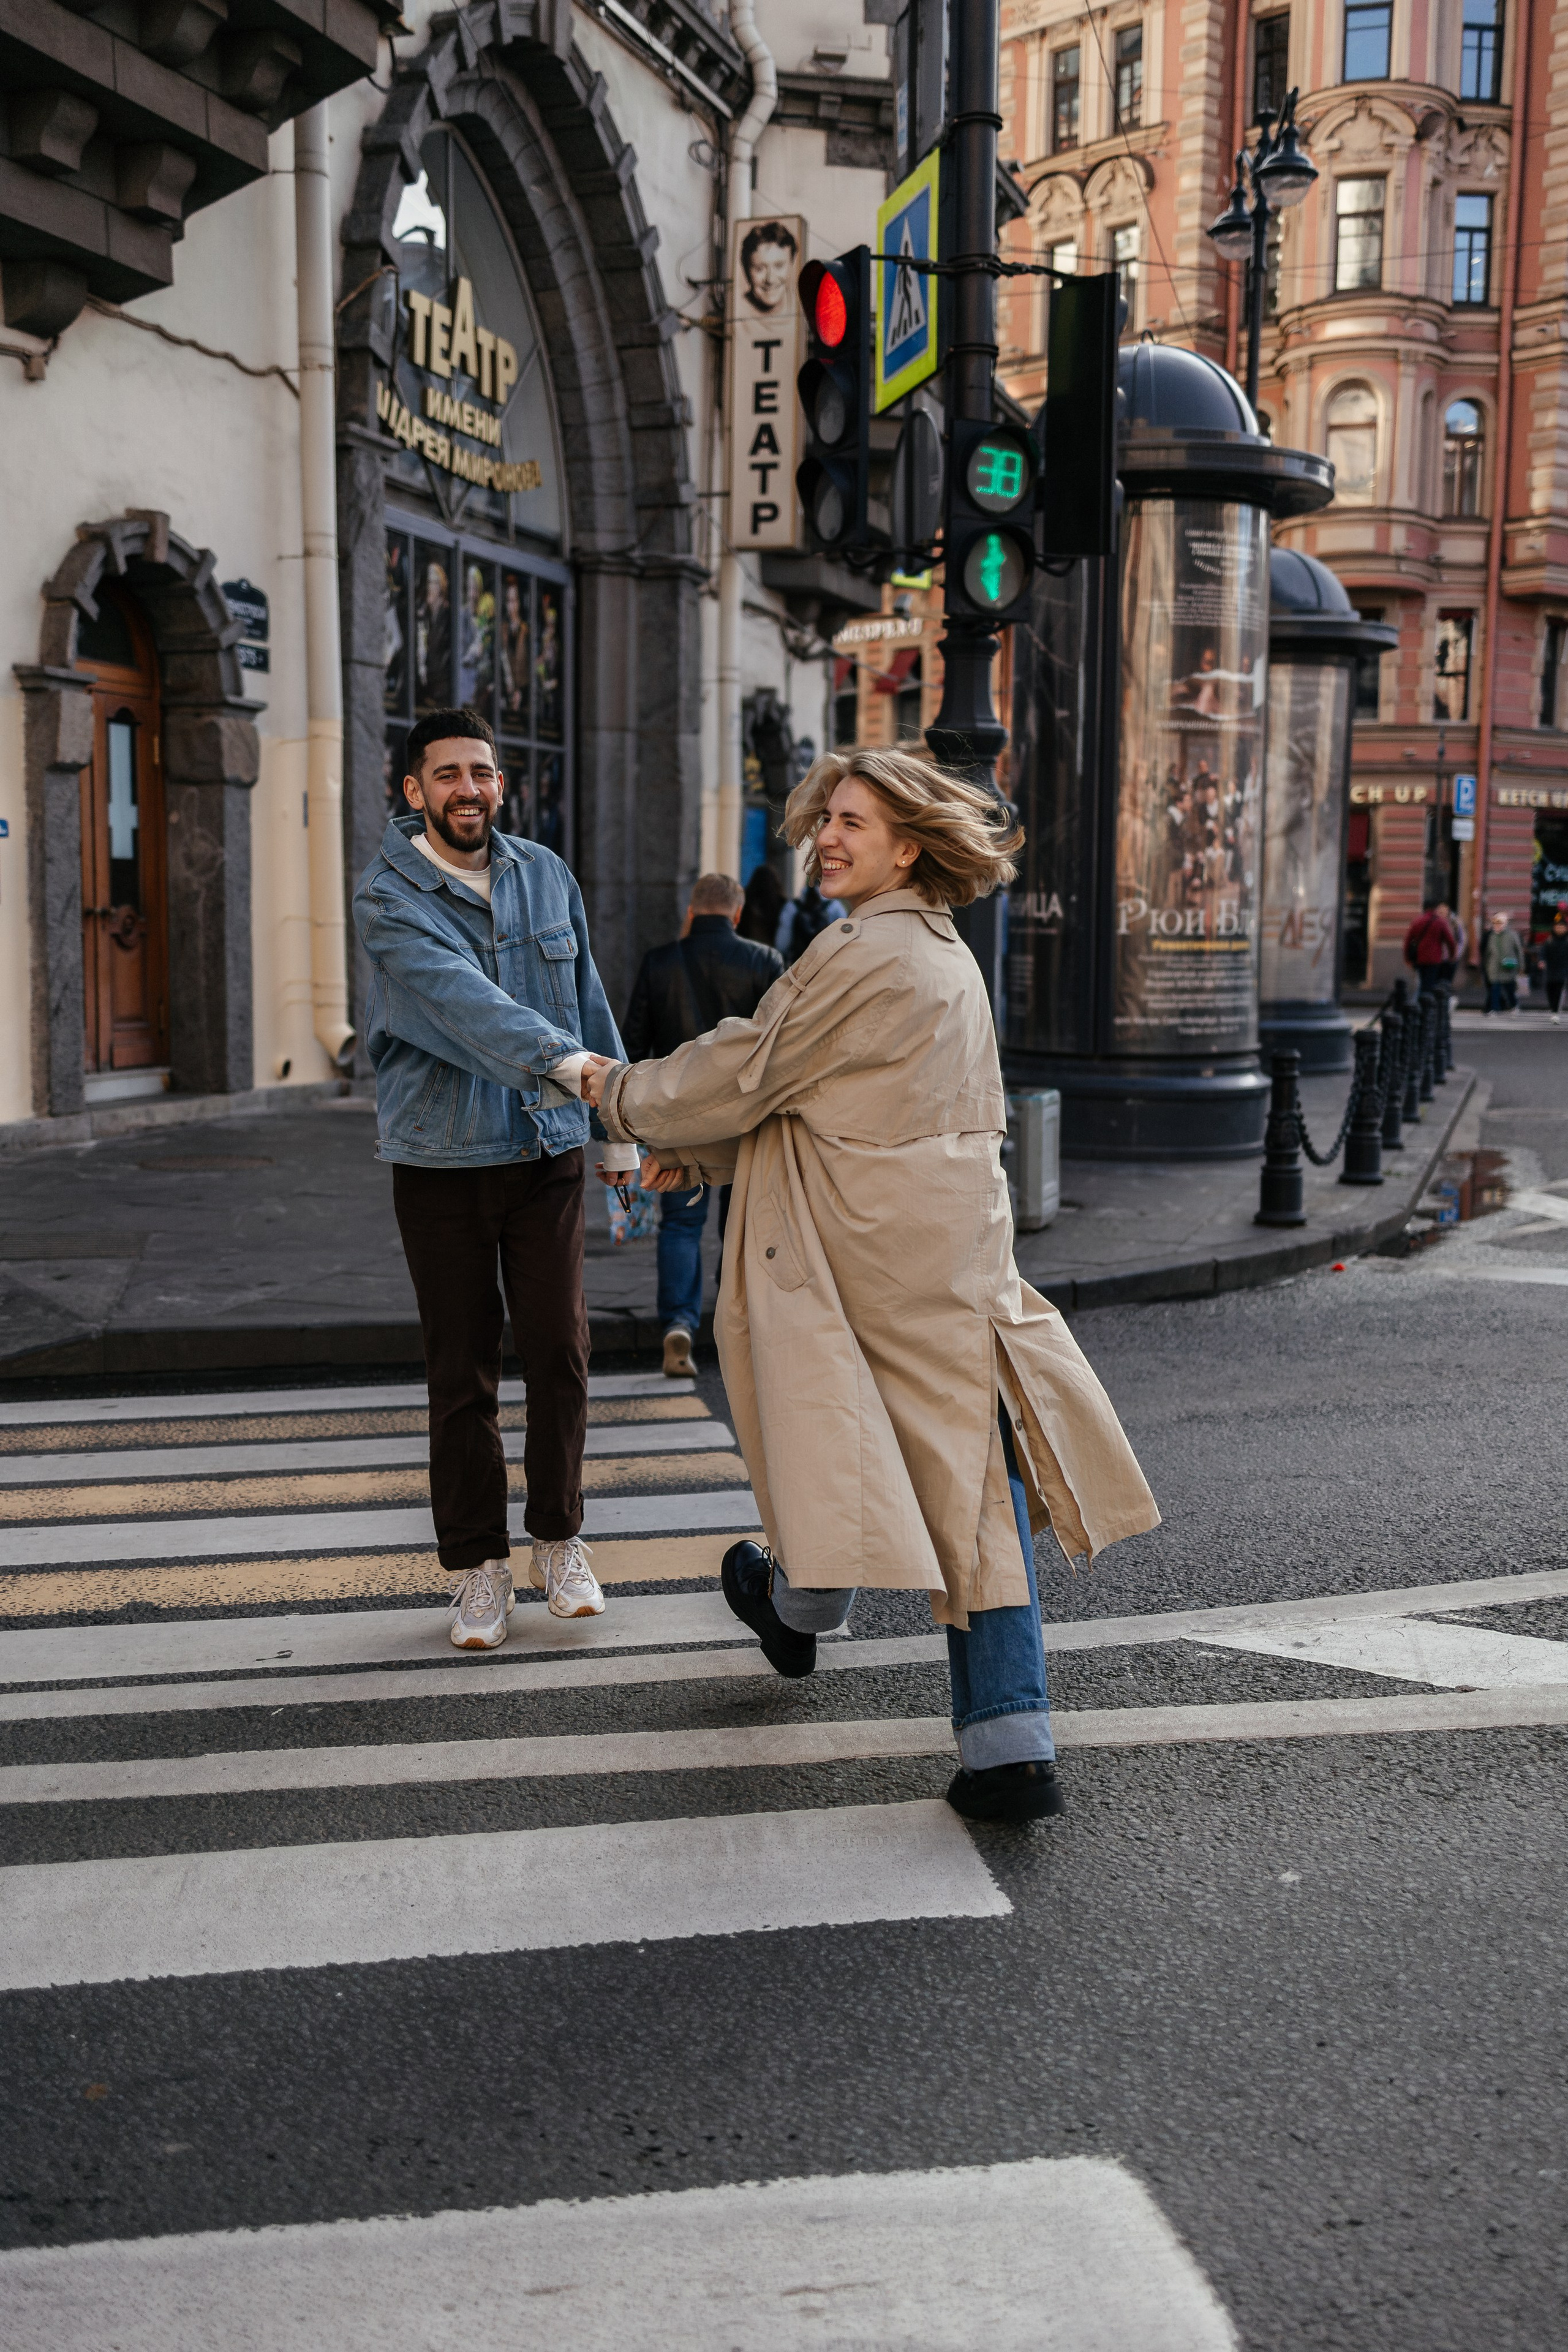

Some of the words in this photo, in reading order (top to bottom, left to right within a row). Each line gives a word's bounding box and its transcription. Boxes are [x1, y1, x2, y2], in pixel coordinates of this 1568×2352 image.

[409, 277, 518, 405] ТЕАТР
[427, 386, 502, 448] ИМЕНИ
[750, 339, 783, 535] ТЕАТР
[977, 447, 1022, 498] 38
